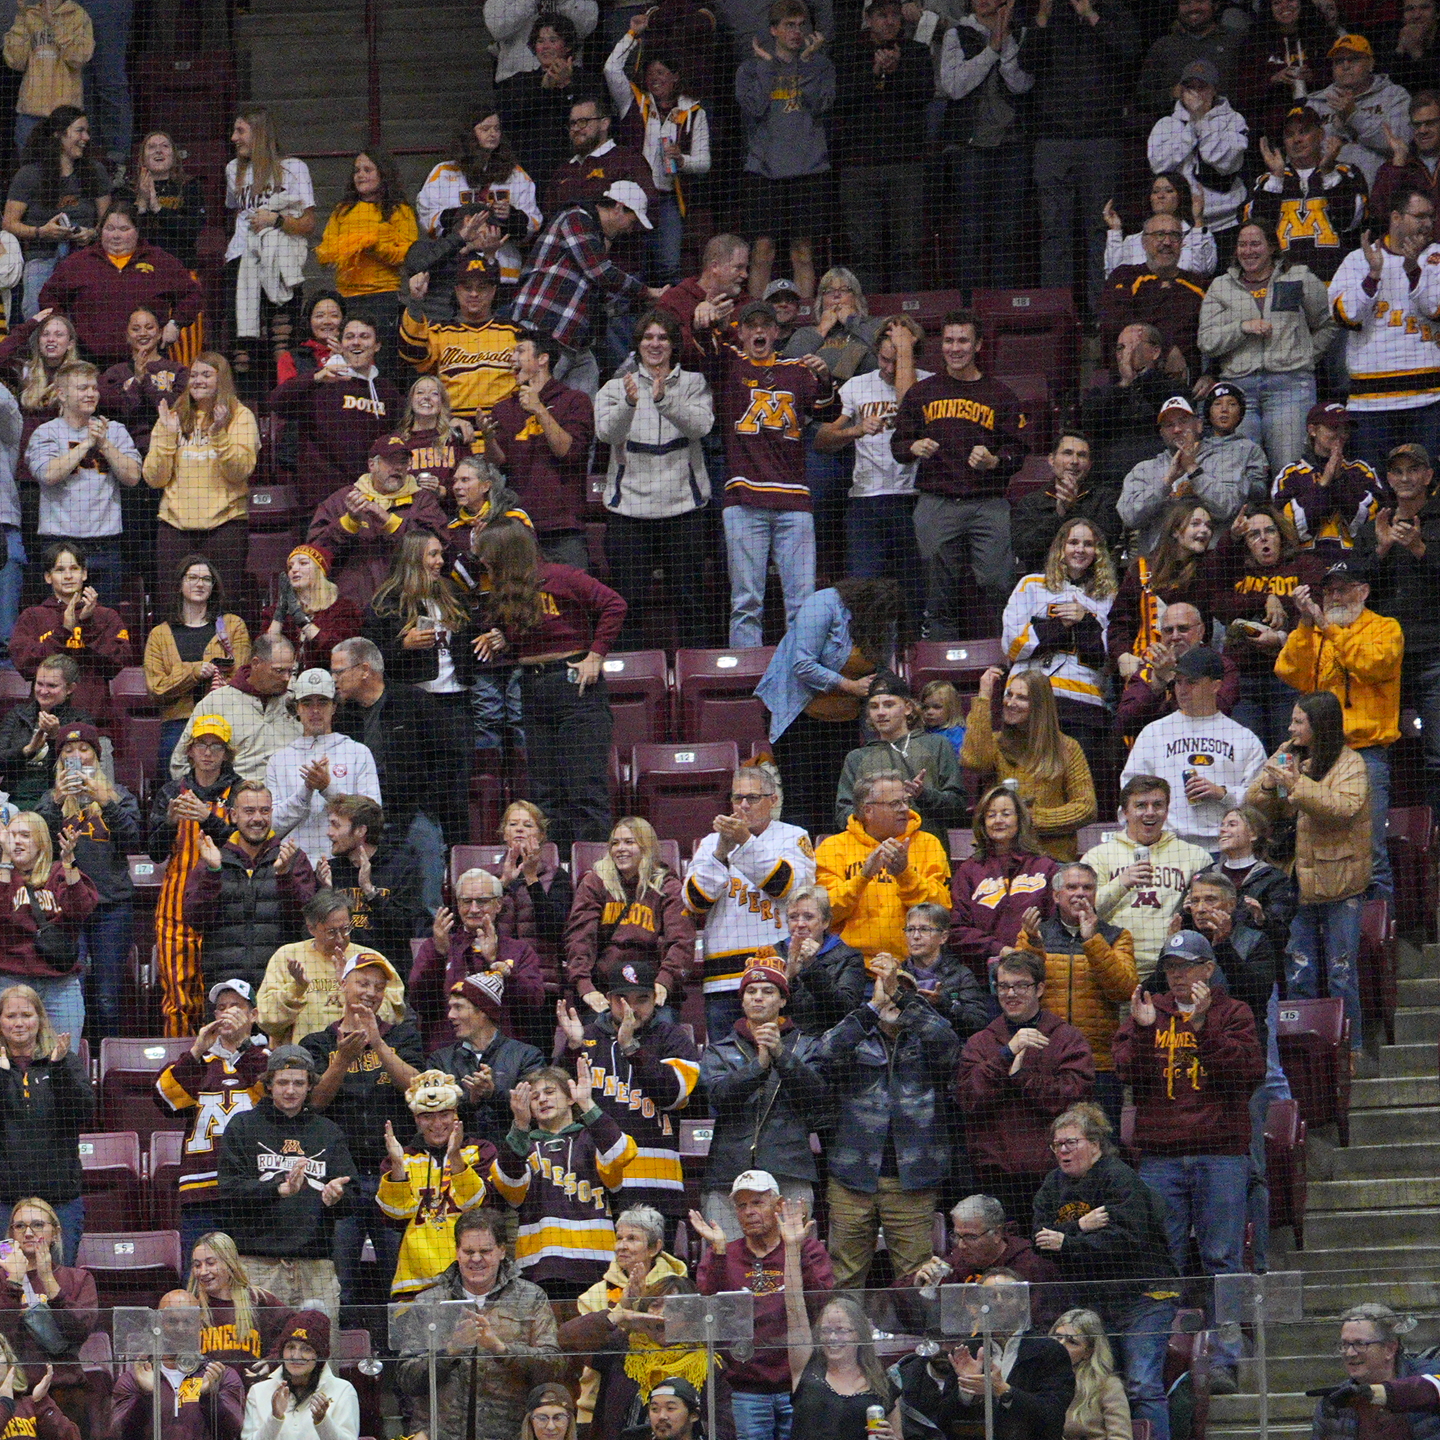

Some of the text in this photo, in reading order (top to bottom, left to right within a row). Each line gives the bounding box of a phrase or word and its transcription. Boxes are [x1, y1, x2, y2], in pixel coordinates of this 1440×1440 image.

[1276, 198, 1340, 252] M
[440, 345, 513, 365] Minnesota
[734, 388, 803, 441] M
[923, 398, 995, 431] MINNESOTA
[1165, 739, 1235, 763] MINNESOTA
[728, 876, 784, 929] PHERS
[1131, 891, 1162, 909] M
[257, 1154, 282, 1171] ROW
